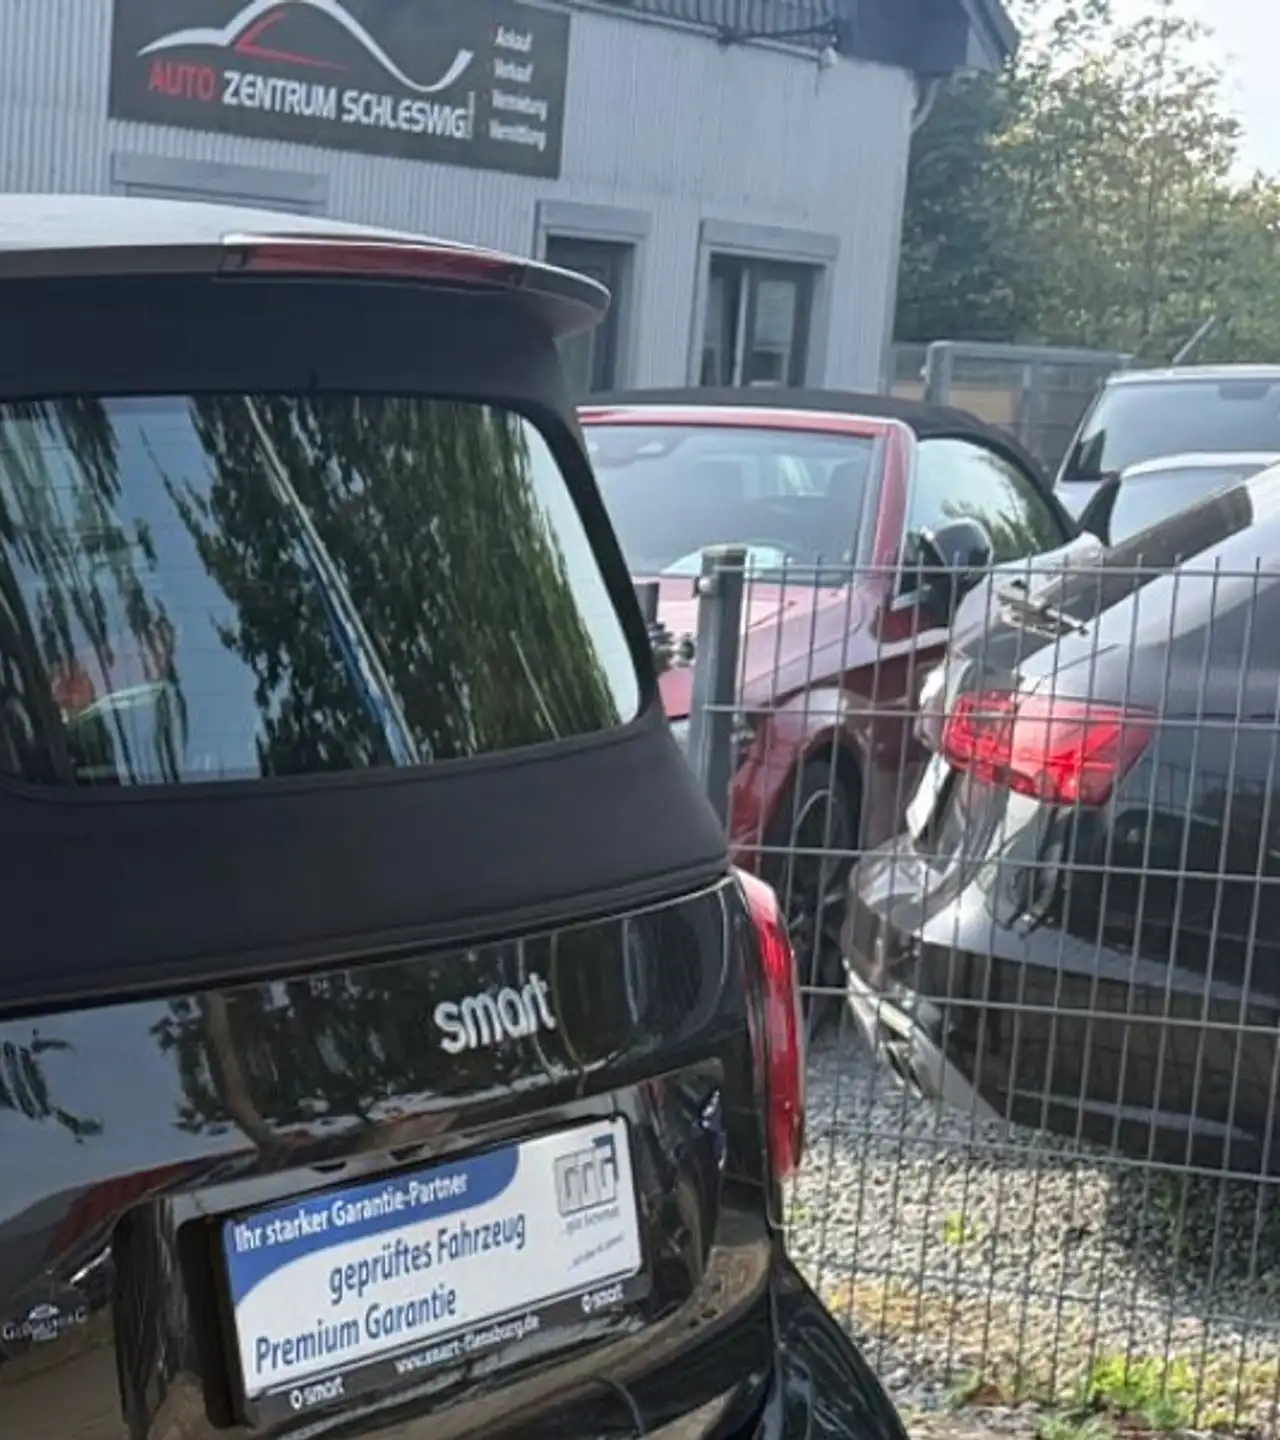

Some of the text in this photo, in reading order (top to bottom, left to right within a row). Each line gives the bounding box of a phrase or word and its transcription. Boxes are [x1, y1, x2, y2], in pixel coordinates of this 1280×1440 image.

[147, 60, 216, 101] AUTO
[221, 69, 337, 119] ZENTRUM
[342, 89, 469, 141] SCHLESWIG
[432, 971, 560, 1054] smart
[233, 1171, 469, 1254] Ihr starker Garantie-Partner
[329, 1240, 433, 1307] geprüftes
[436, 1212, 527, 1265] Fahrzeug
[254, 1282, 458, 1375] Premium Garantie
